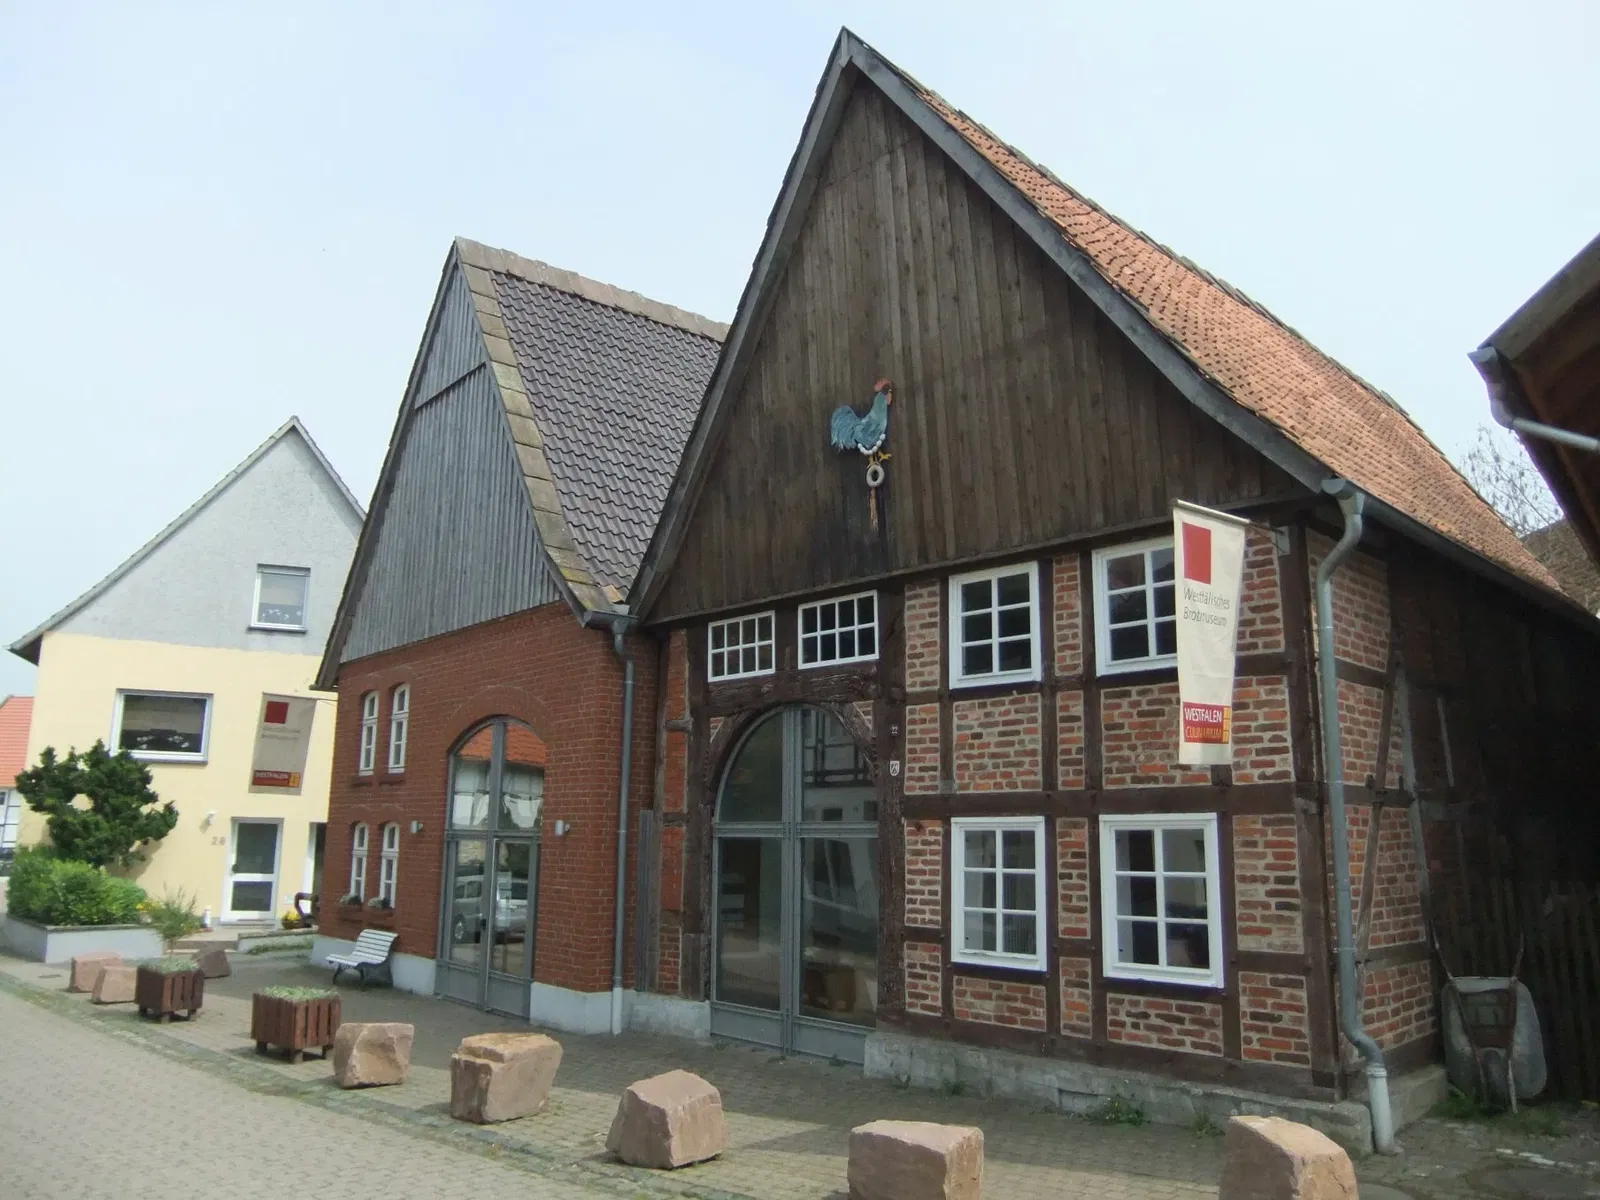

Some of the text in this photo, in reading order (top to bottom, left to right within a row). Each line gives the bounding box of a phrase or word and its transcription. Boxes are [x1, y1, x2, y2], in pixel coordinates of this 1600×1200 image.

[1183, 587, 1230, 609] Westfälisches
[1183, 606, 1227, 627] Brotmuseum
[1184, 707, 1222, 723] WESTFALEN
